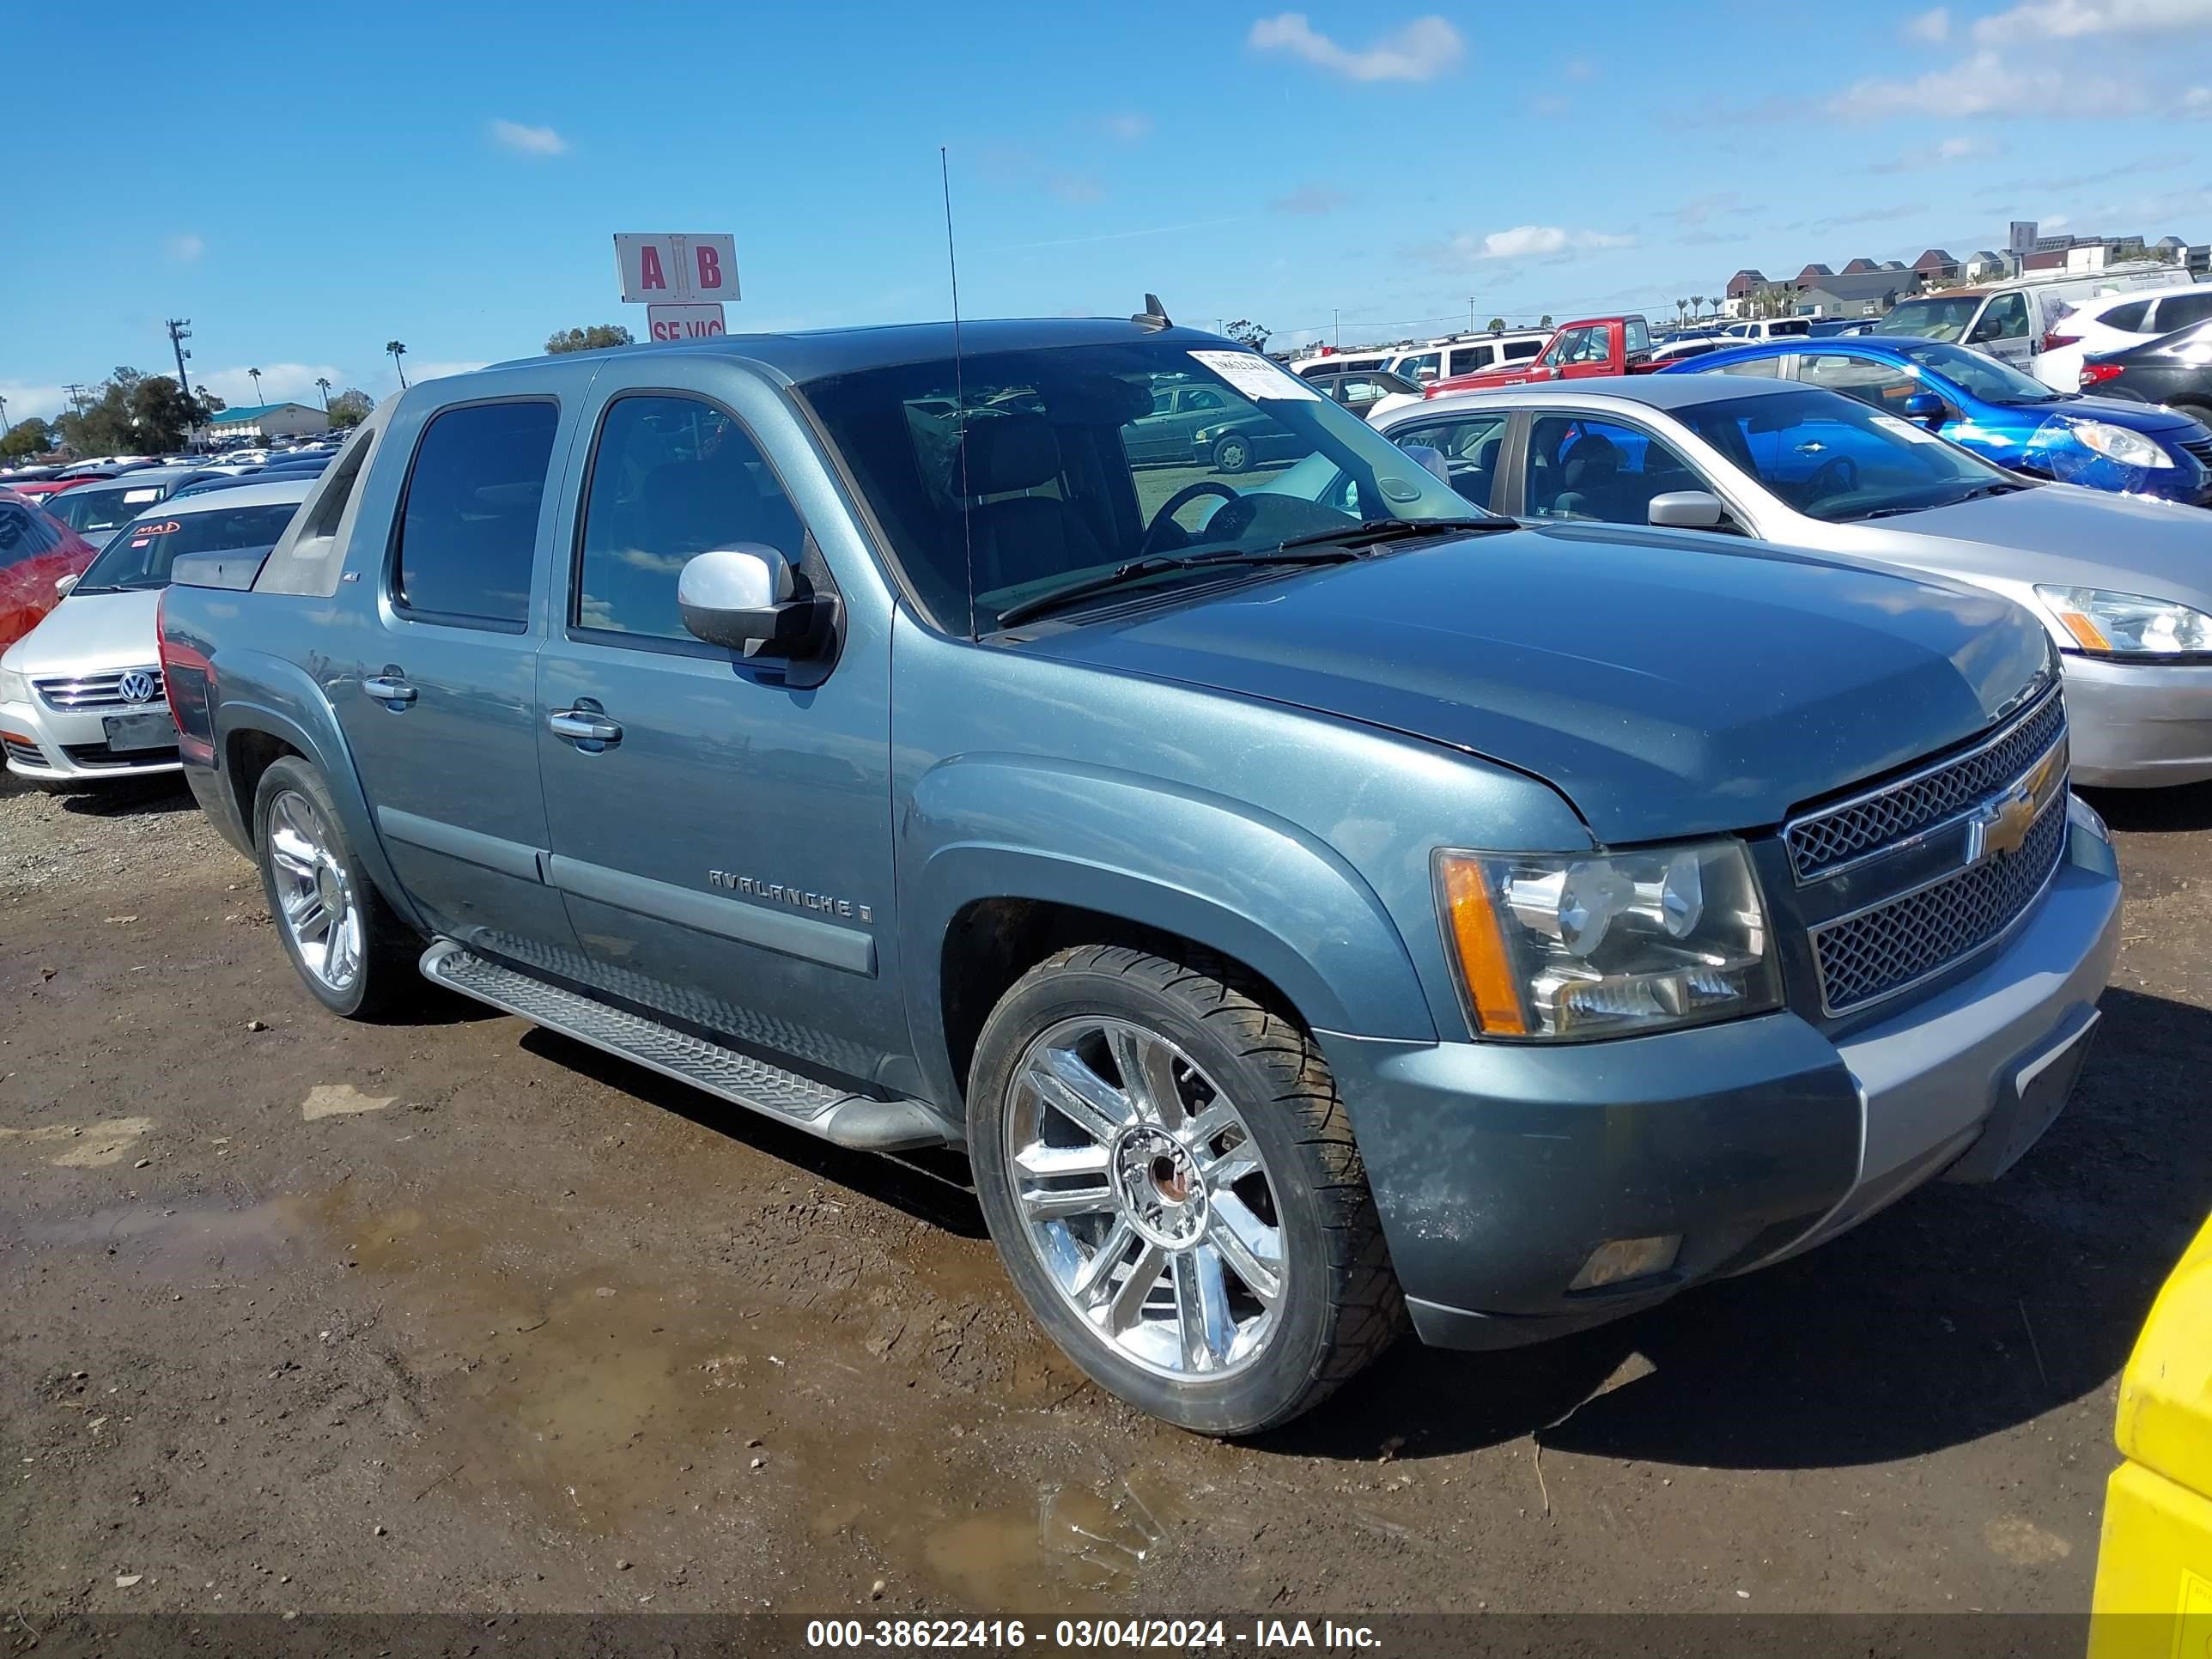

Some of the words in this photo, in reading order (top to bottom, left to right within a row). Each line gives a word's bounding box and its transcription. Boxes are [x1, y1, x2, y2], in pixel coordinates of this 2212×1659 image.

[641, 246, 666, 289] A
[696, 246, 722, 289] B
[708, 869, 853, 919] AVALANCHE
